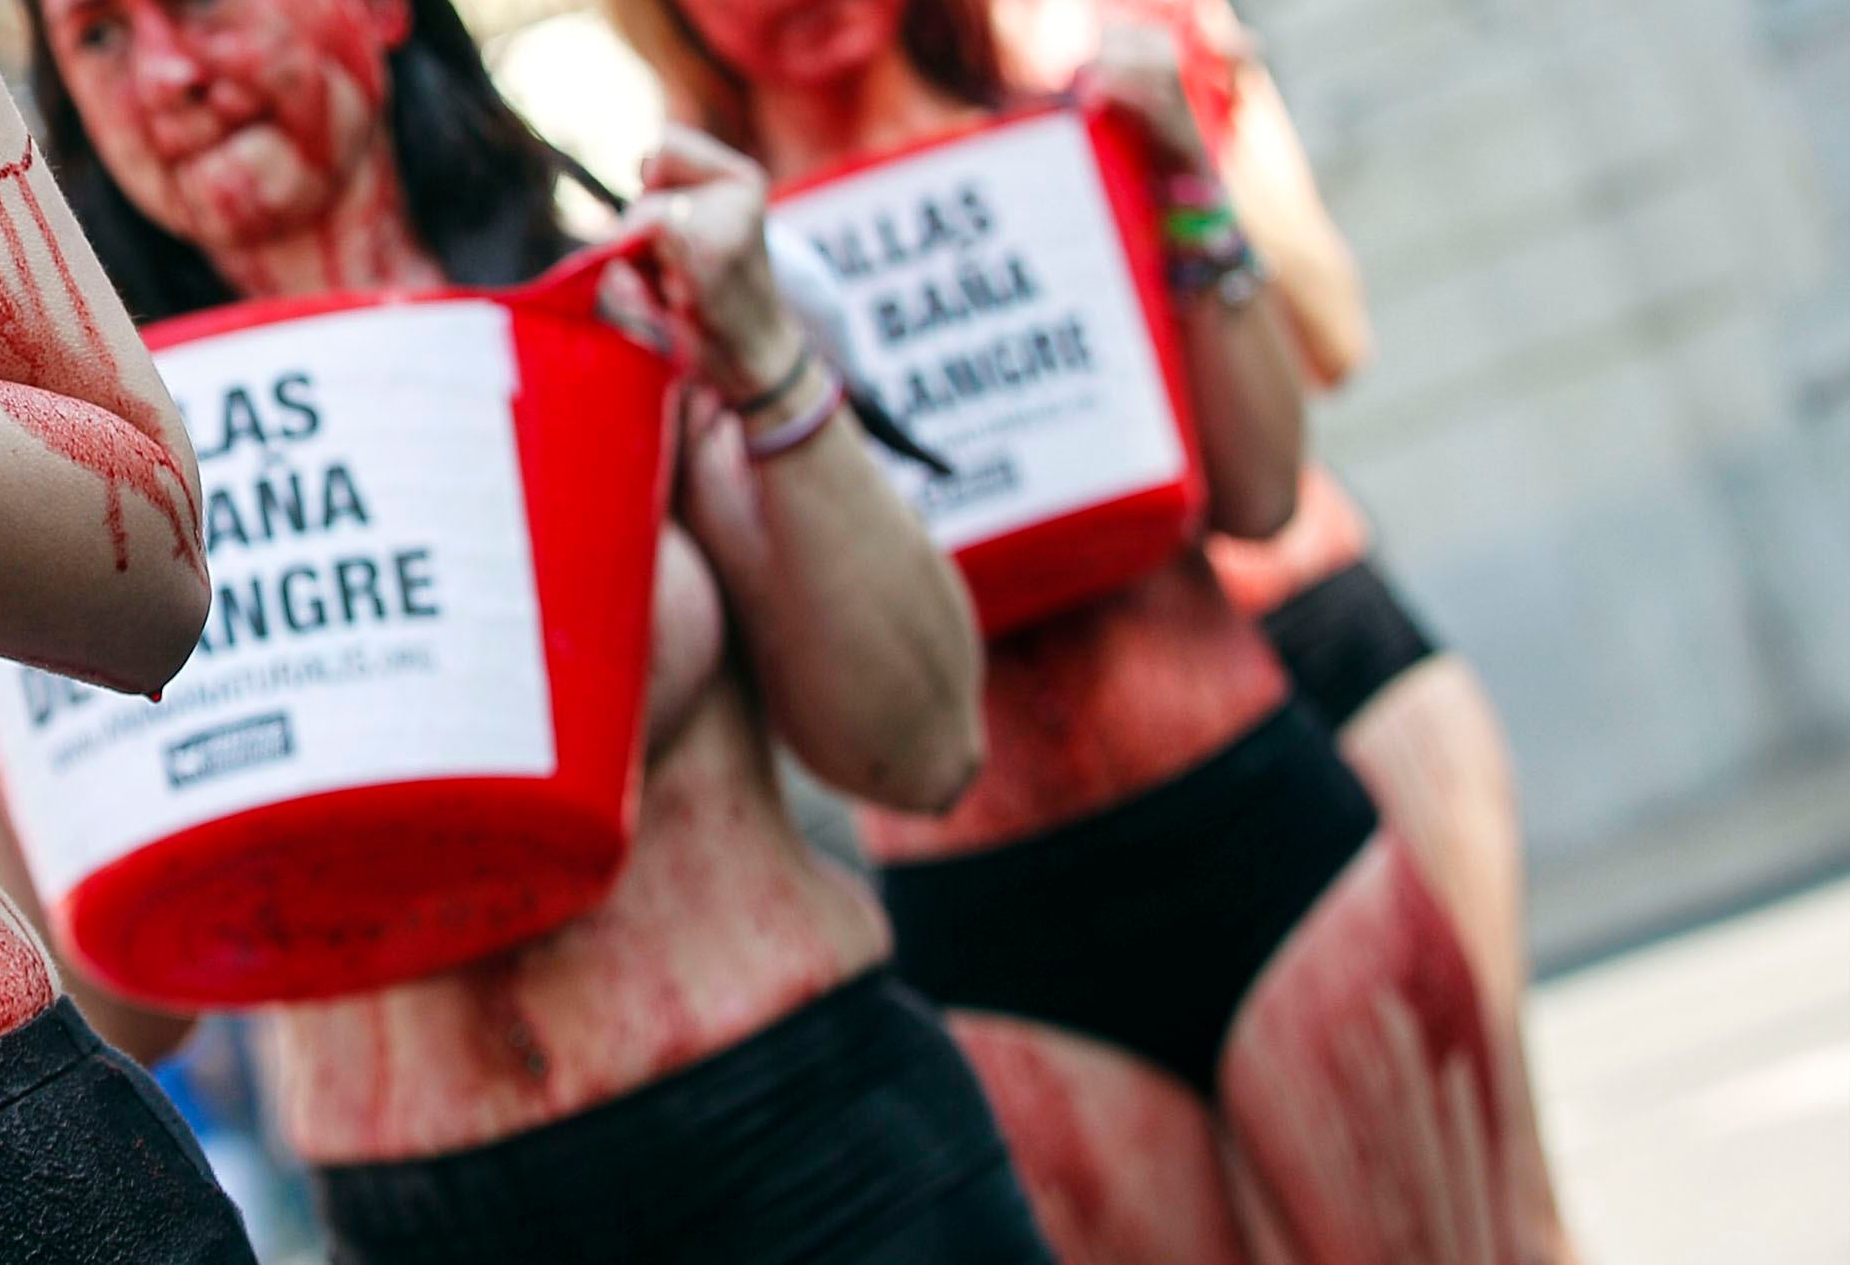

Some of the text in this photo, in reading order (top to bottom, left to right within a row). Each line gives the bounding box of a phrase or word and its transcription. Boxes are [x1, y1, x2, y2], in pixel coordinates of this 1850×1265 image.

[812, 180, 995, 278] ALLAS
[902, 317, 1097, 413] ANGRE
[204, 451, 371, 556] AÑA
[200, 547, 441, 655] NGRE
